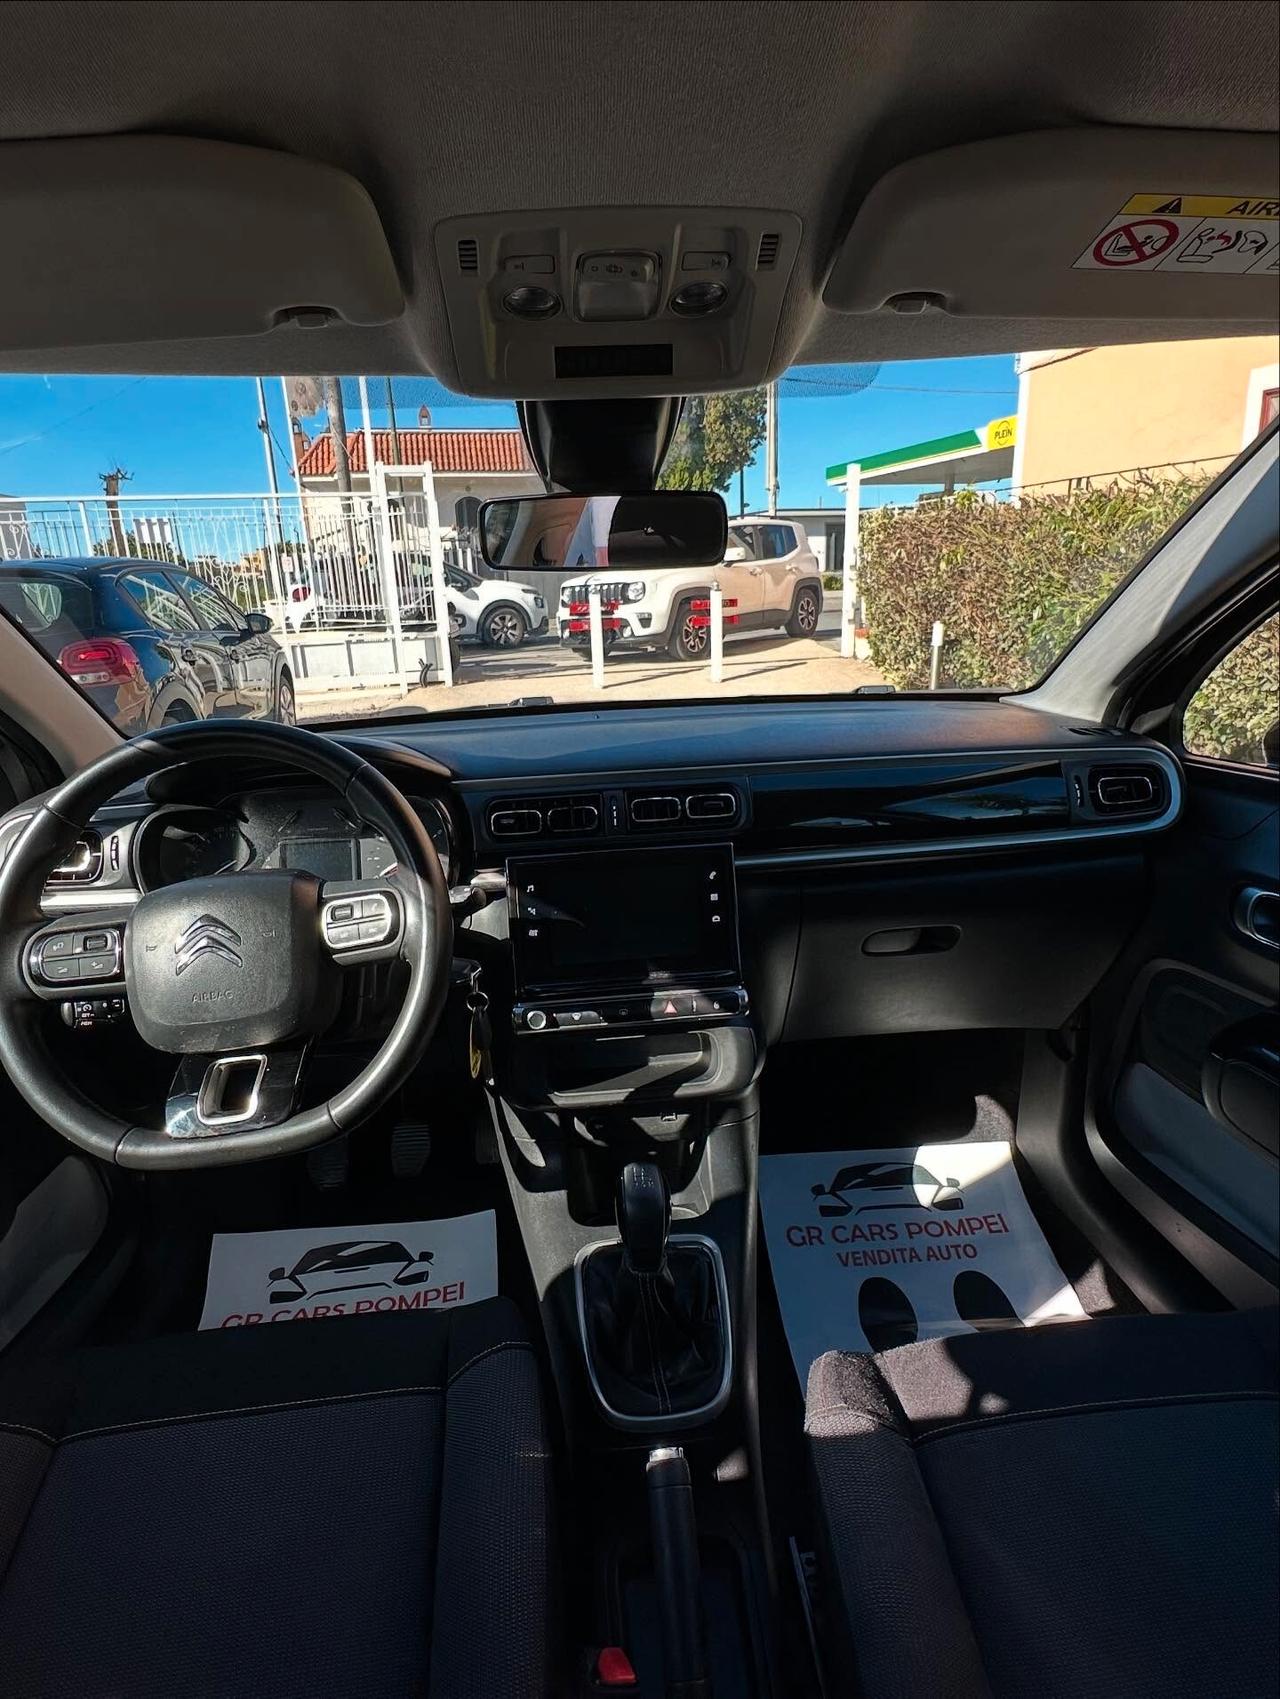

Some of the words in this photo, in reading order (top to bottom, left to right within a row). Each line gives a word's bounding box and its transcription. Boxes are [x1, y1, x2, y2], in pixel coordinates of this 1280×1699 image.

[1225, 200, 1279, 216] AIR
[192, 989, 234, 1003] AIRBAG
[785, 1225, 825, 1247] GR
[831, 1223, 899, 1244] CARS
[904, 1213, 1010, 1239] POMPEI
[837, 1247, 923, 1267] VENDITA
[926, 1243, 978, 1262] AUTO
[355, 1281, 465, 1314] POMPEI
